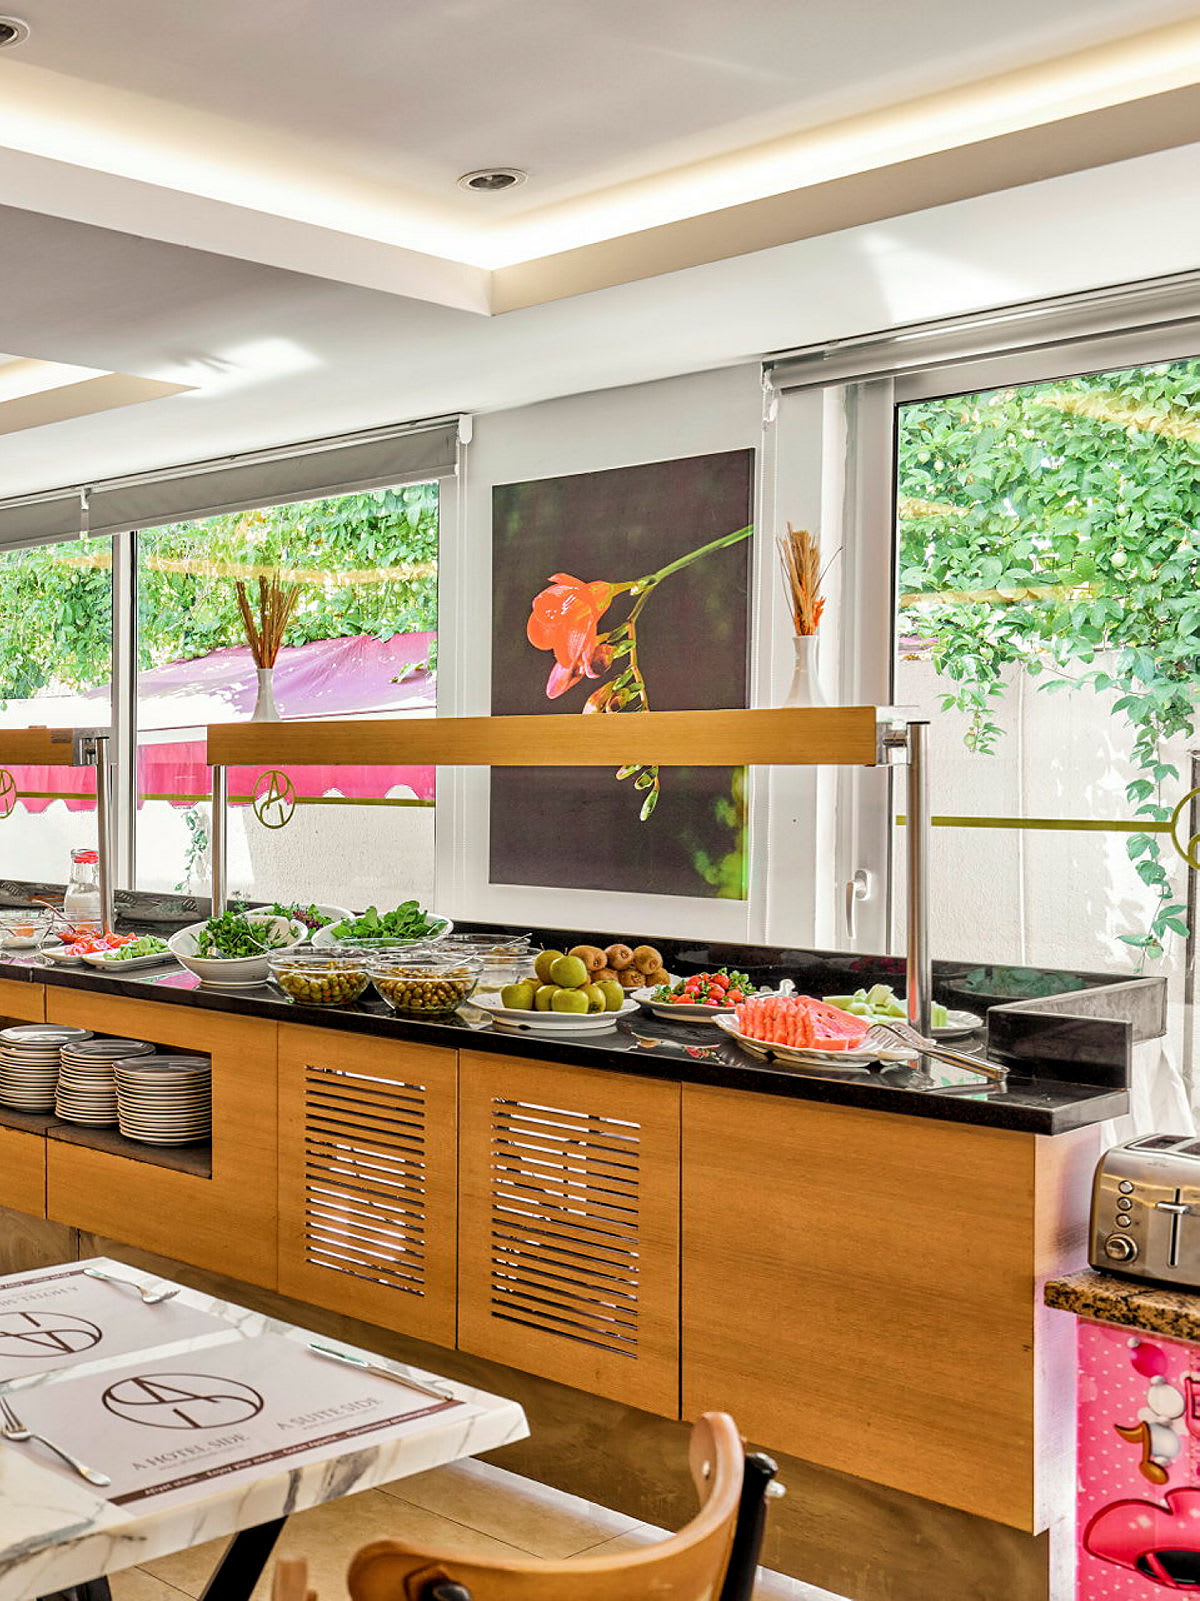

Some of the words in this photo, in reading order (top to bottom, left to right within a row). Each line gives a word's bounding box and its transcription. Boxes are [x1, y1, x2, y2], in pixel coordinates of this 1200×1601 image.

[289, 1408, 343, 1425] SUITE
[340, 1397, 384, 1411] SIDE
[145, 1444, 209, 1466] HOTEL
[208, 1433, 250, 1448] SIDE
